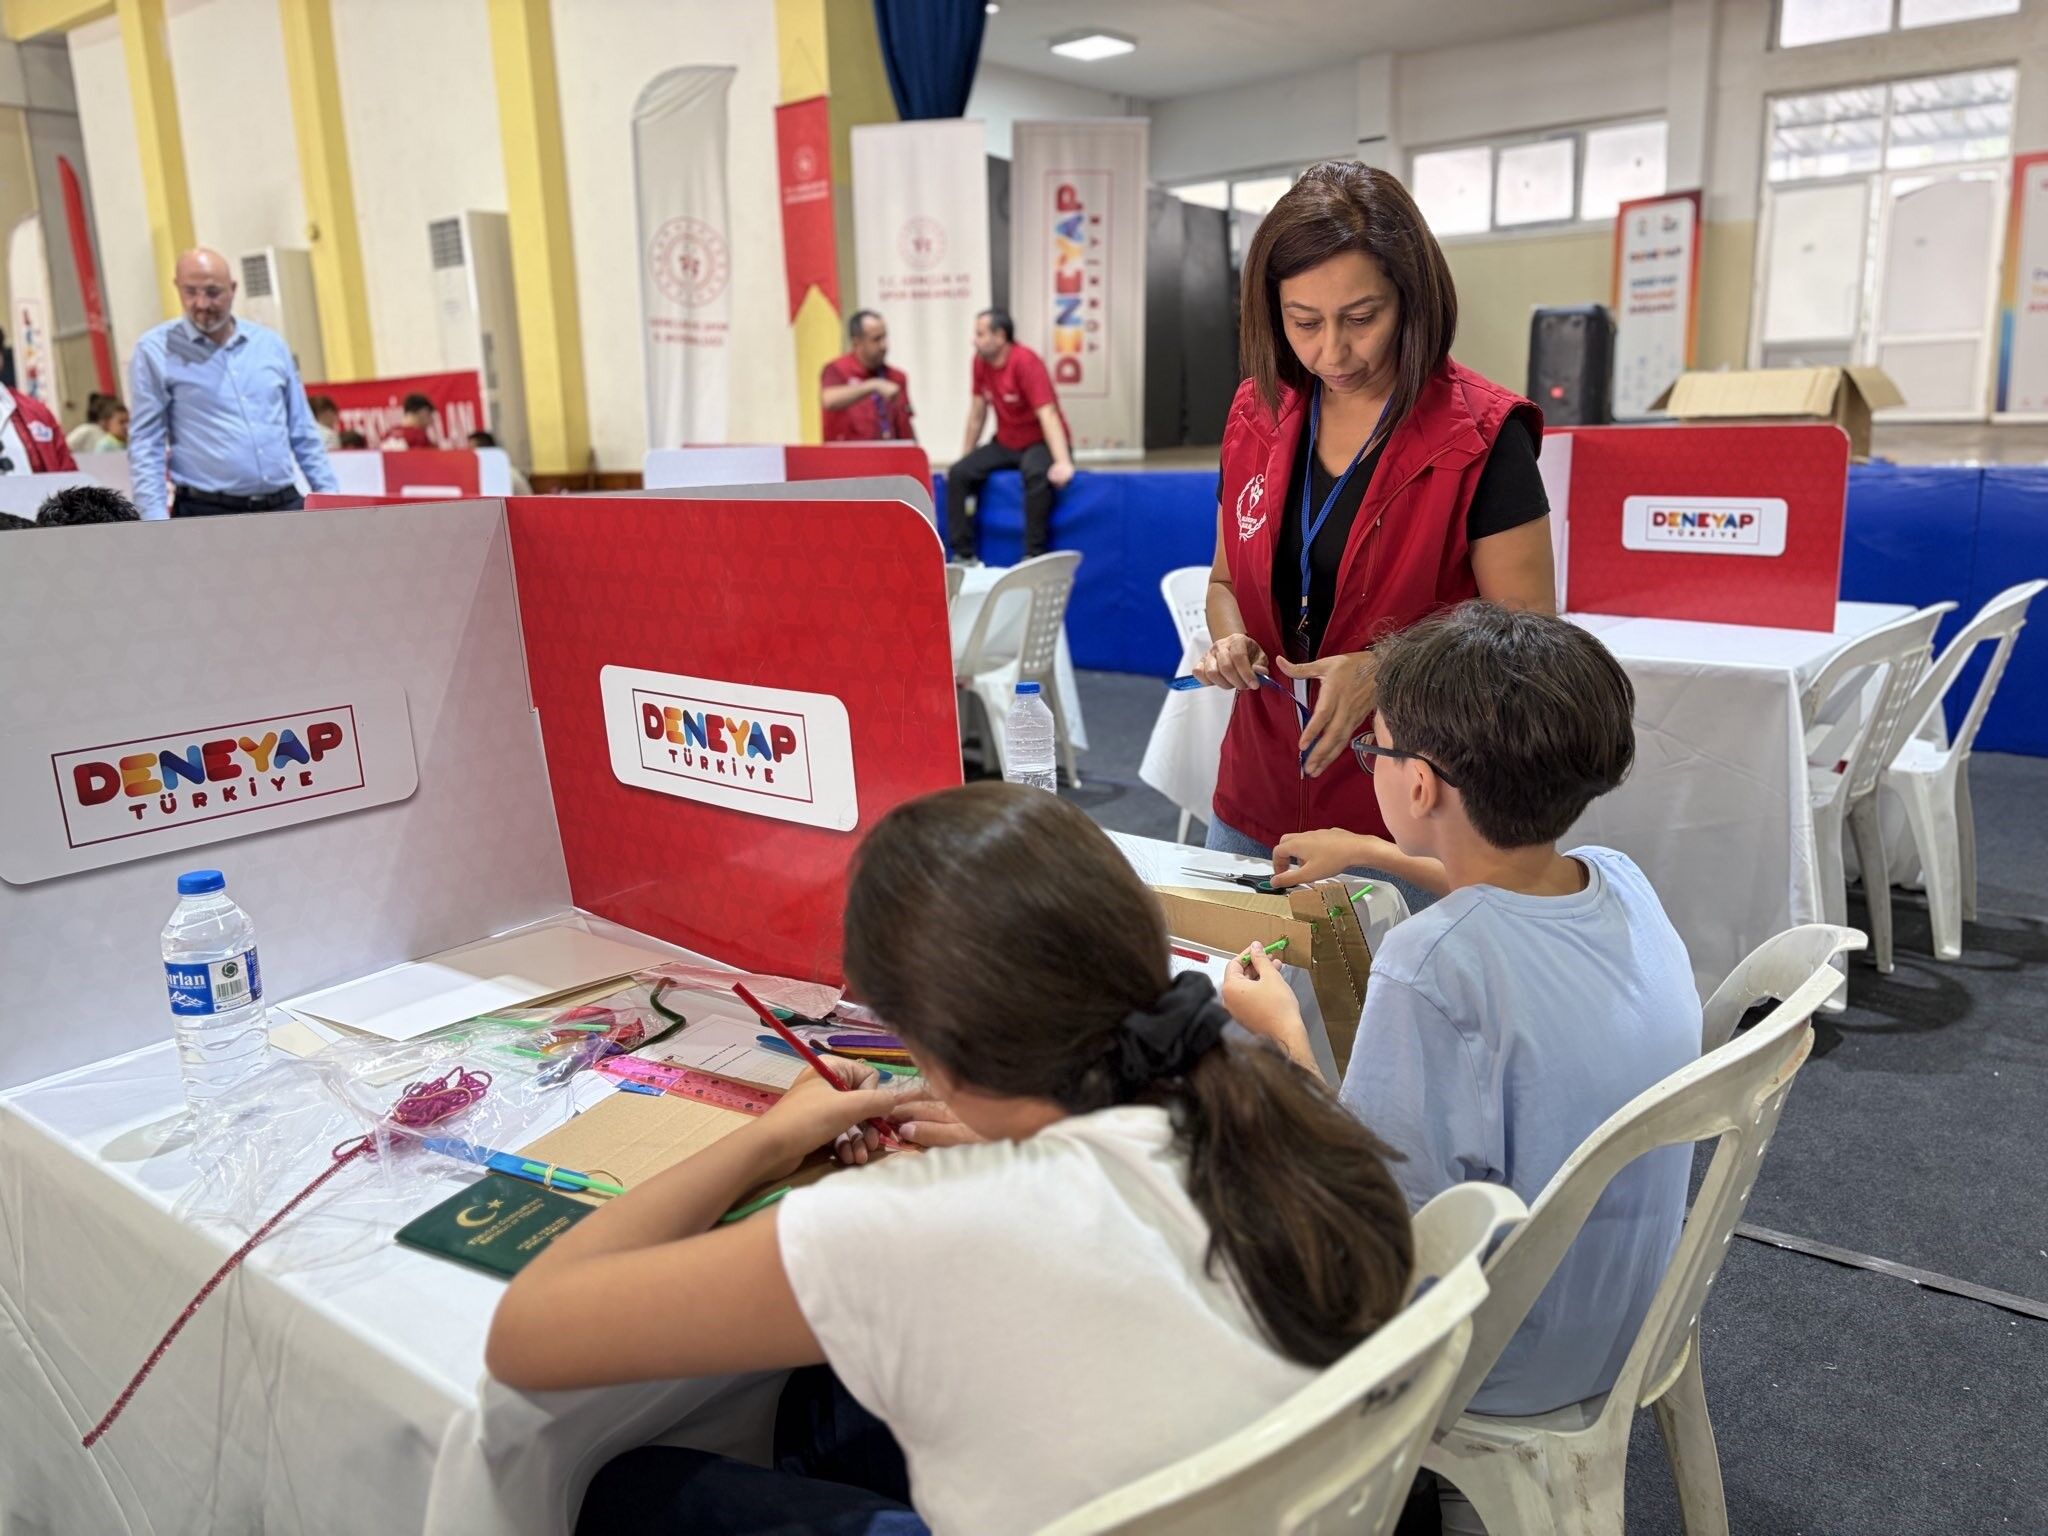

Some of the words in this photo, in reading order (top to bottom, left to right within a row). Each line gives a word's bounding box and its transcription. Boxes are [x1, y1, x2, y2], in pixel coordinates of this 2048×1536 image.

[1054, 183, 1084, 385] DENEYAP
[1652, 511, 1754, 529] DENEYAP
[642, 702, 797, 763] DENEYAP
[73, 721, 343, 807] DENEYAP
[668, 747, 775, 784] TÜRKİYE
[128, 771, 313, 820] TÜRKİYE
